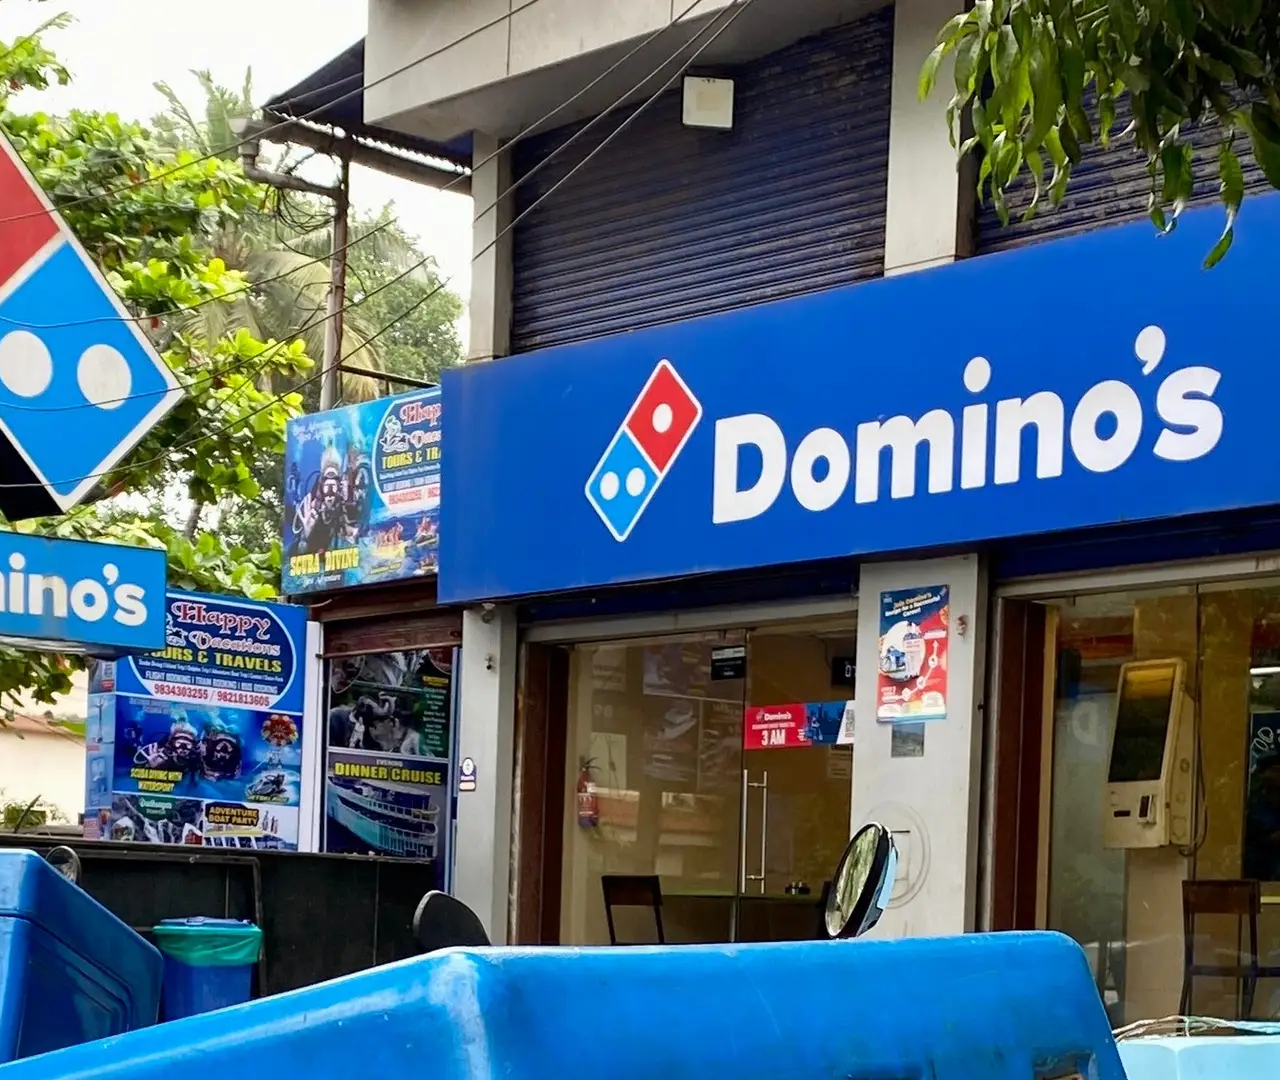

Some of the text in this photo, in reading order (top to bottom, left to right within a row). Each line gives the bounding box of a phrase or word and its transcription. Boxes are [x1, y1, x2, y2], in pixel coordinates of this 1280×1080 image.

[713, 325, 1224, 524] Domino's
[171, 601, 270, 640] Happy
[189, 631, 281, 657] Vacations
[197, 650, 209, 663] &
[214, 652, 282, 673] TRAVELS
[154, 684, 208, 700] 9834303255
[761, 730, 769, 746] 3
[770, 729, 786, 745] AM
[334, 762, 441, 785] DINNER CRUISE
[209, 806, 257, 817] ADVENTURE
